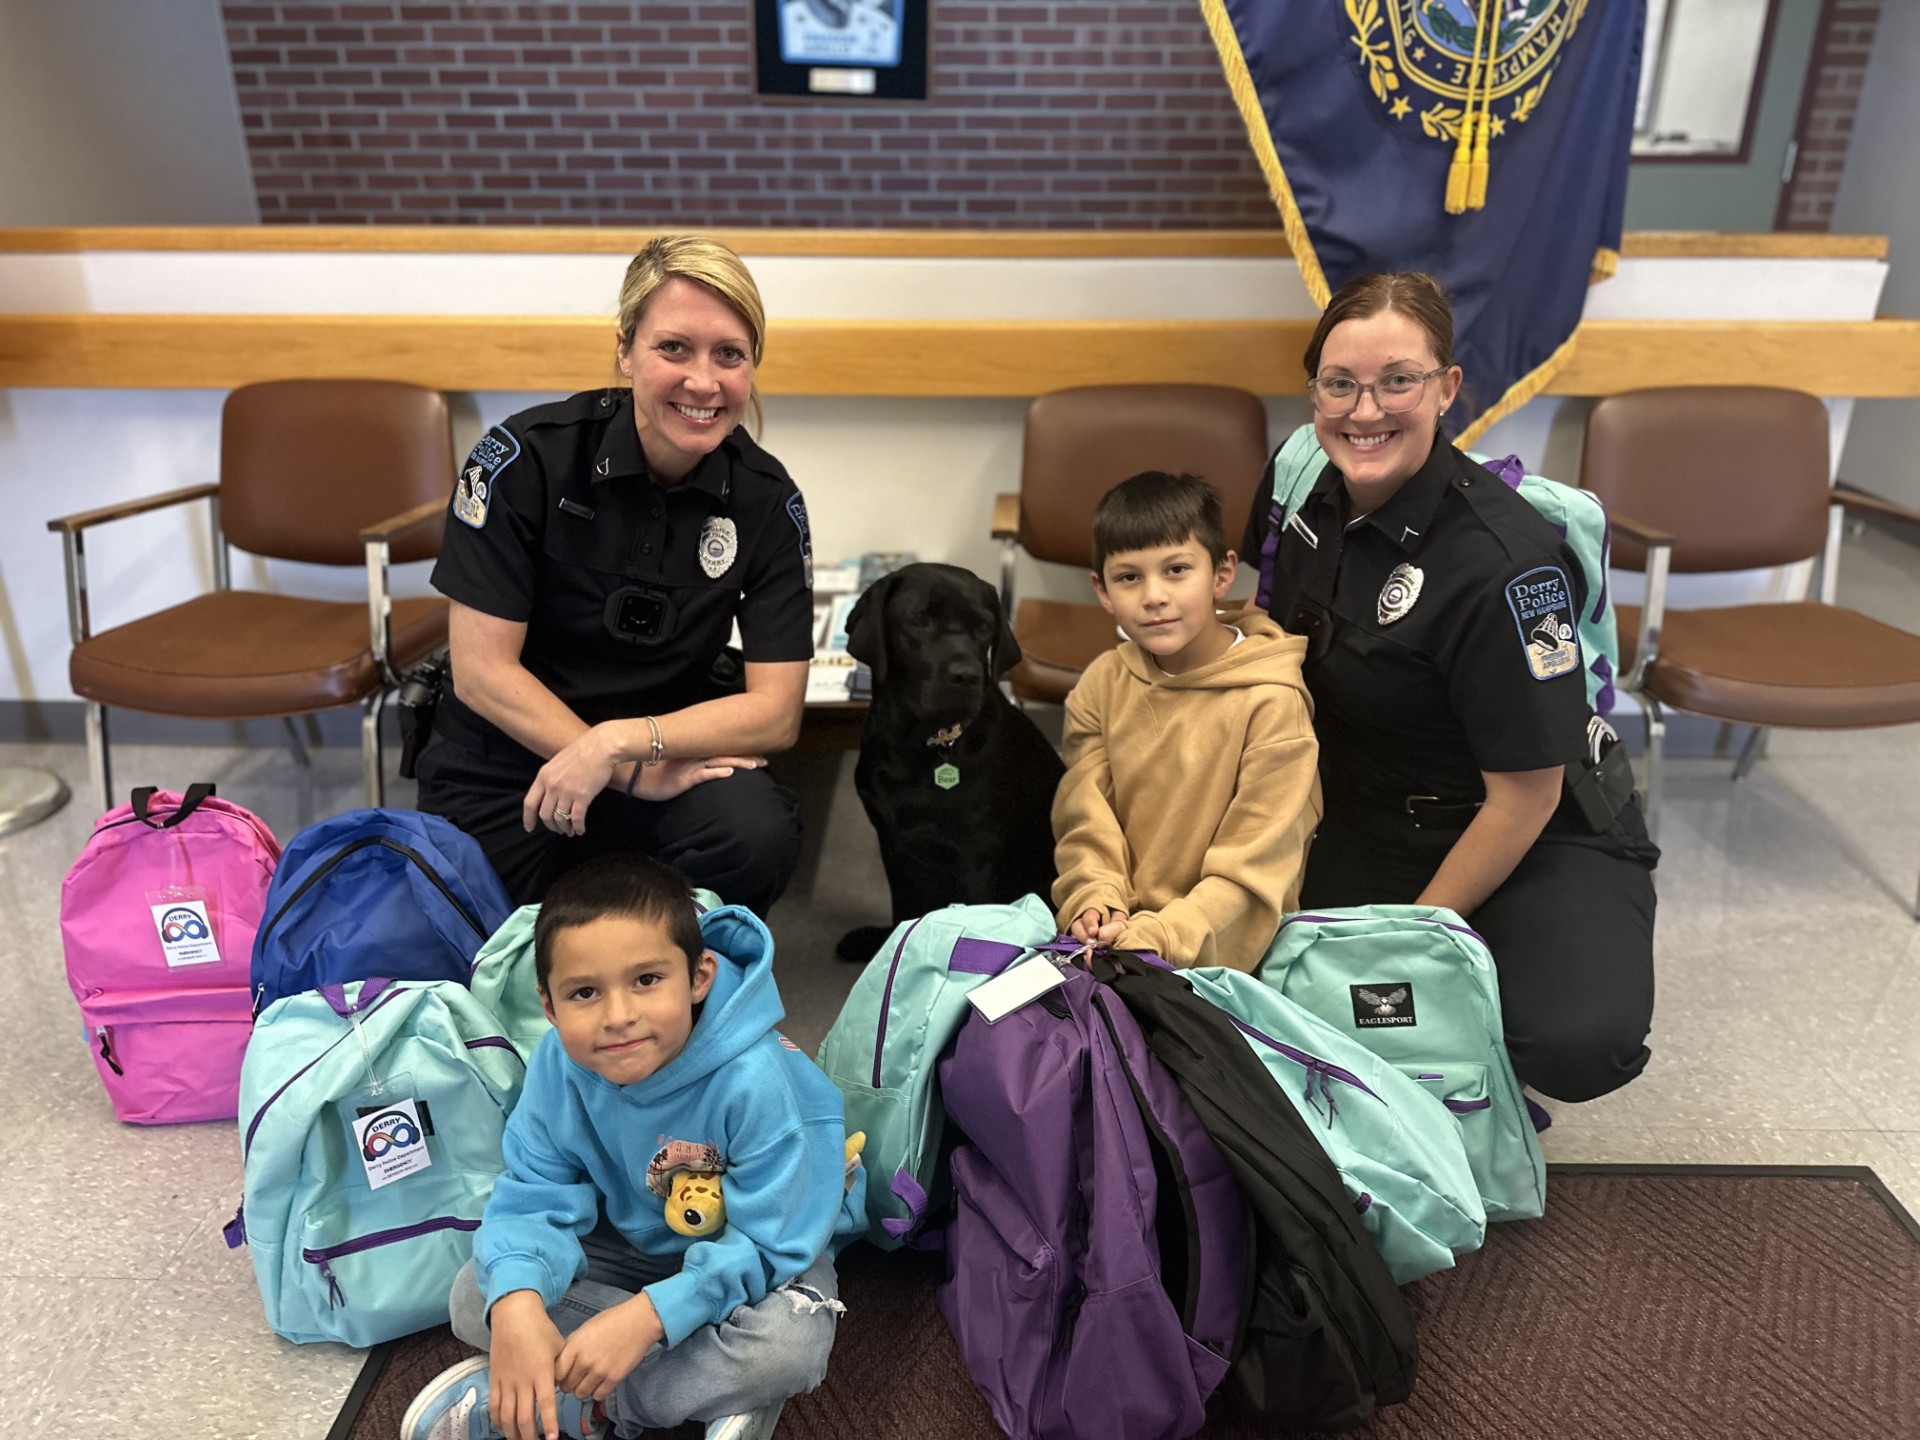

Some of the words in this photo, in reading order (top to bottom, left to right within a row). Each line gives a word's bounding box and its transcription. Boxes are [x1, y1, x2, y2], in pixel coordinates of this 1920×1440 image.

[482, 435, 510, 455] erry
[1512, 578, 1560, 599] Derry
[1517, 590, 1566, 611] Police
[168, 913, 192, 922] DERRY
[1359, 1016, 1413, 1025] EAGLESPORT
[371, 1116, 401, 1133] DERRY
